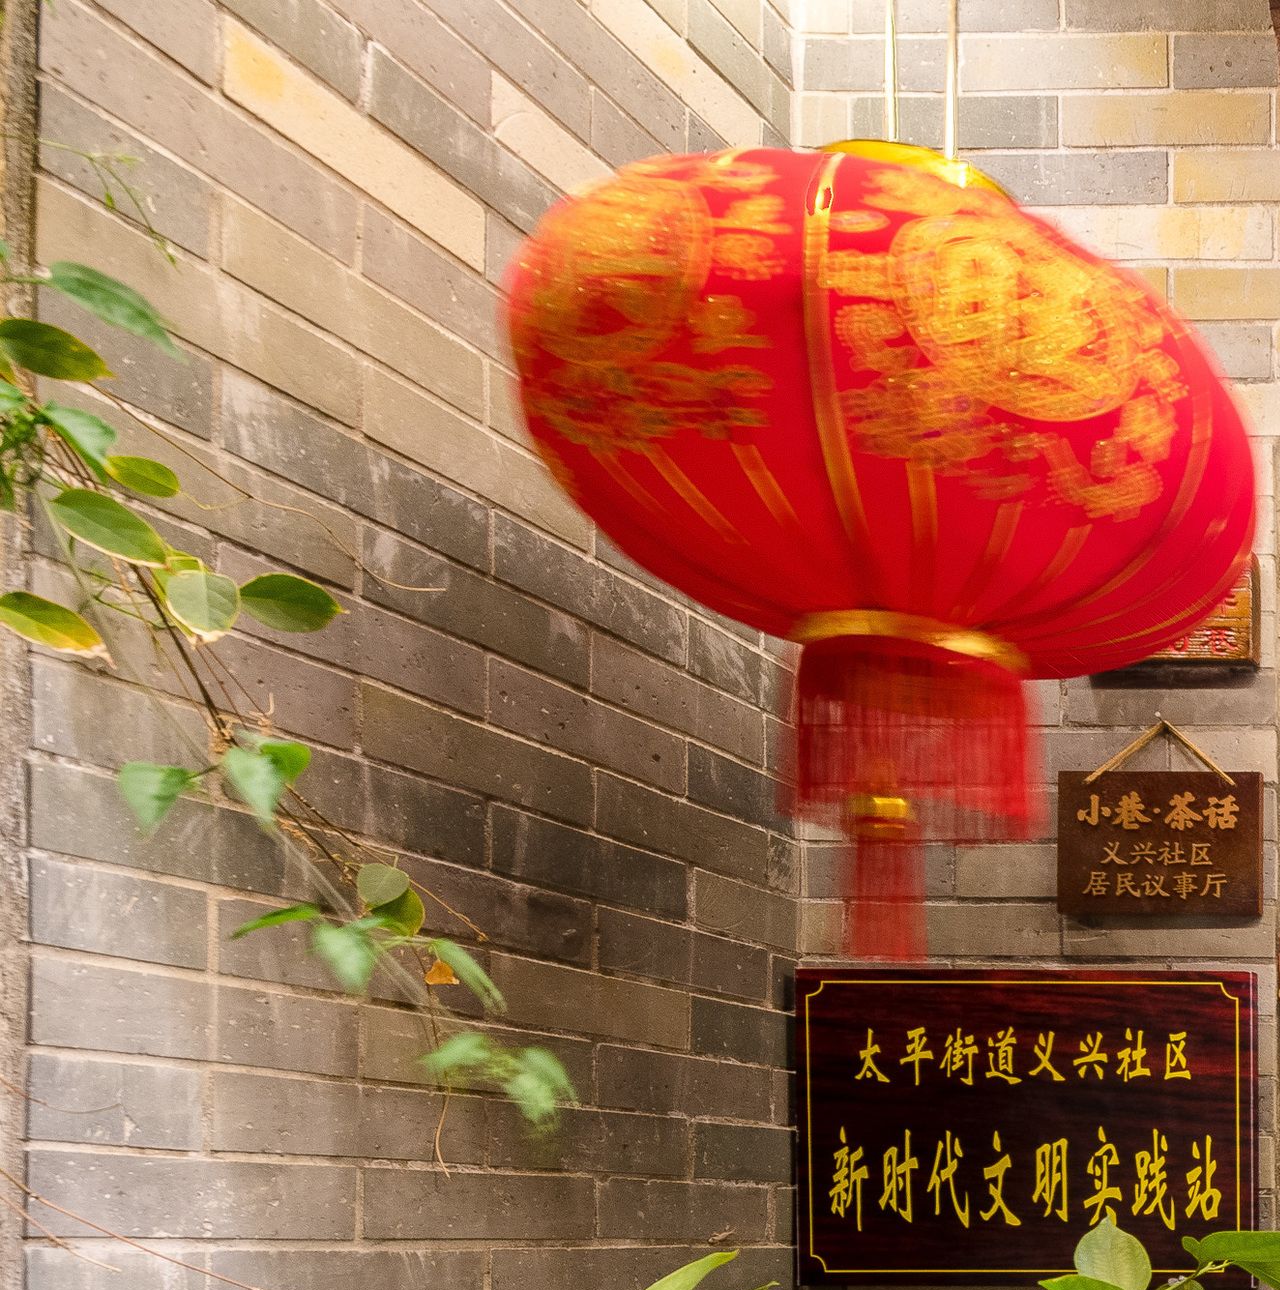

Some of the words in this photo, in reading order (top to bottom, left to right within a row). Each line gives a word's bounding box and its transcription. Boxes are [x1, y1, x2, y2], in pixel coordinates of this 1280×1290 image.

[1076, 791, 1240, 831] 小巷·茶话
[1100, 841, 1213, 866] 义兴社区
[1082, 871, 1228, 899] 居民议事厅
[854, 1026, 1192, 1086] 太平街道义兴社区
[828, 1126, 1222, 1231] 新时代文明实践站
